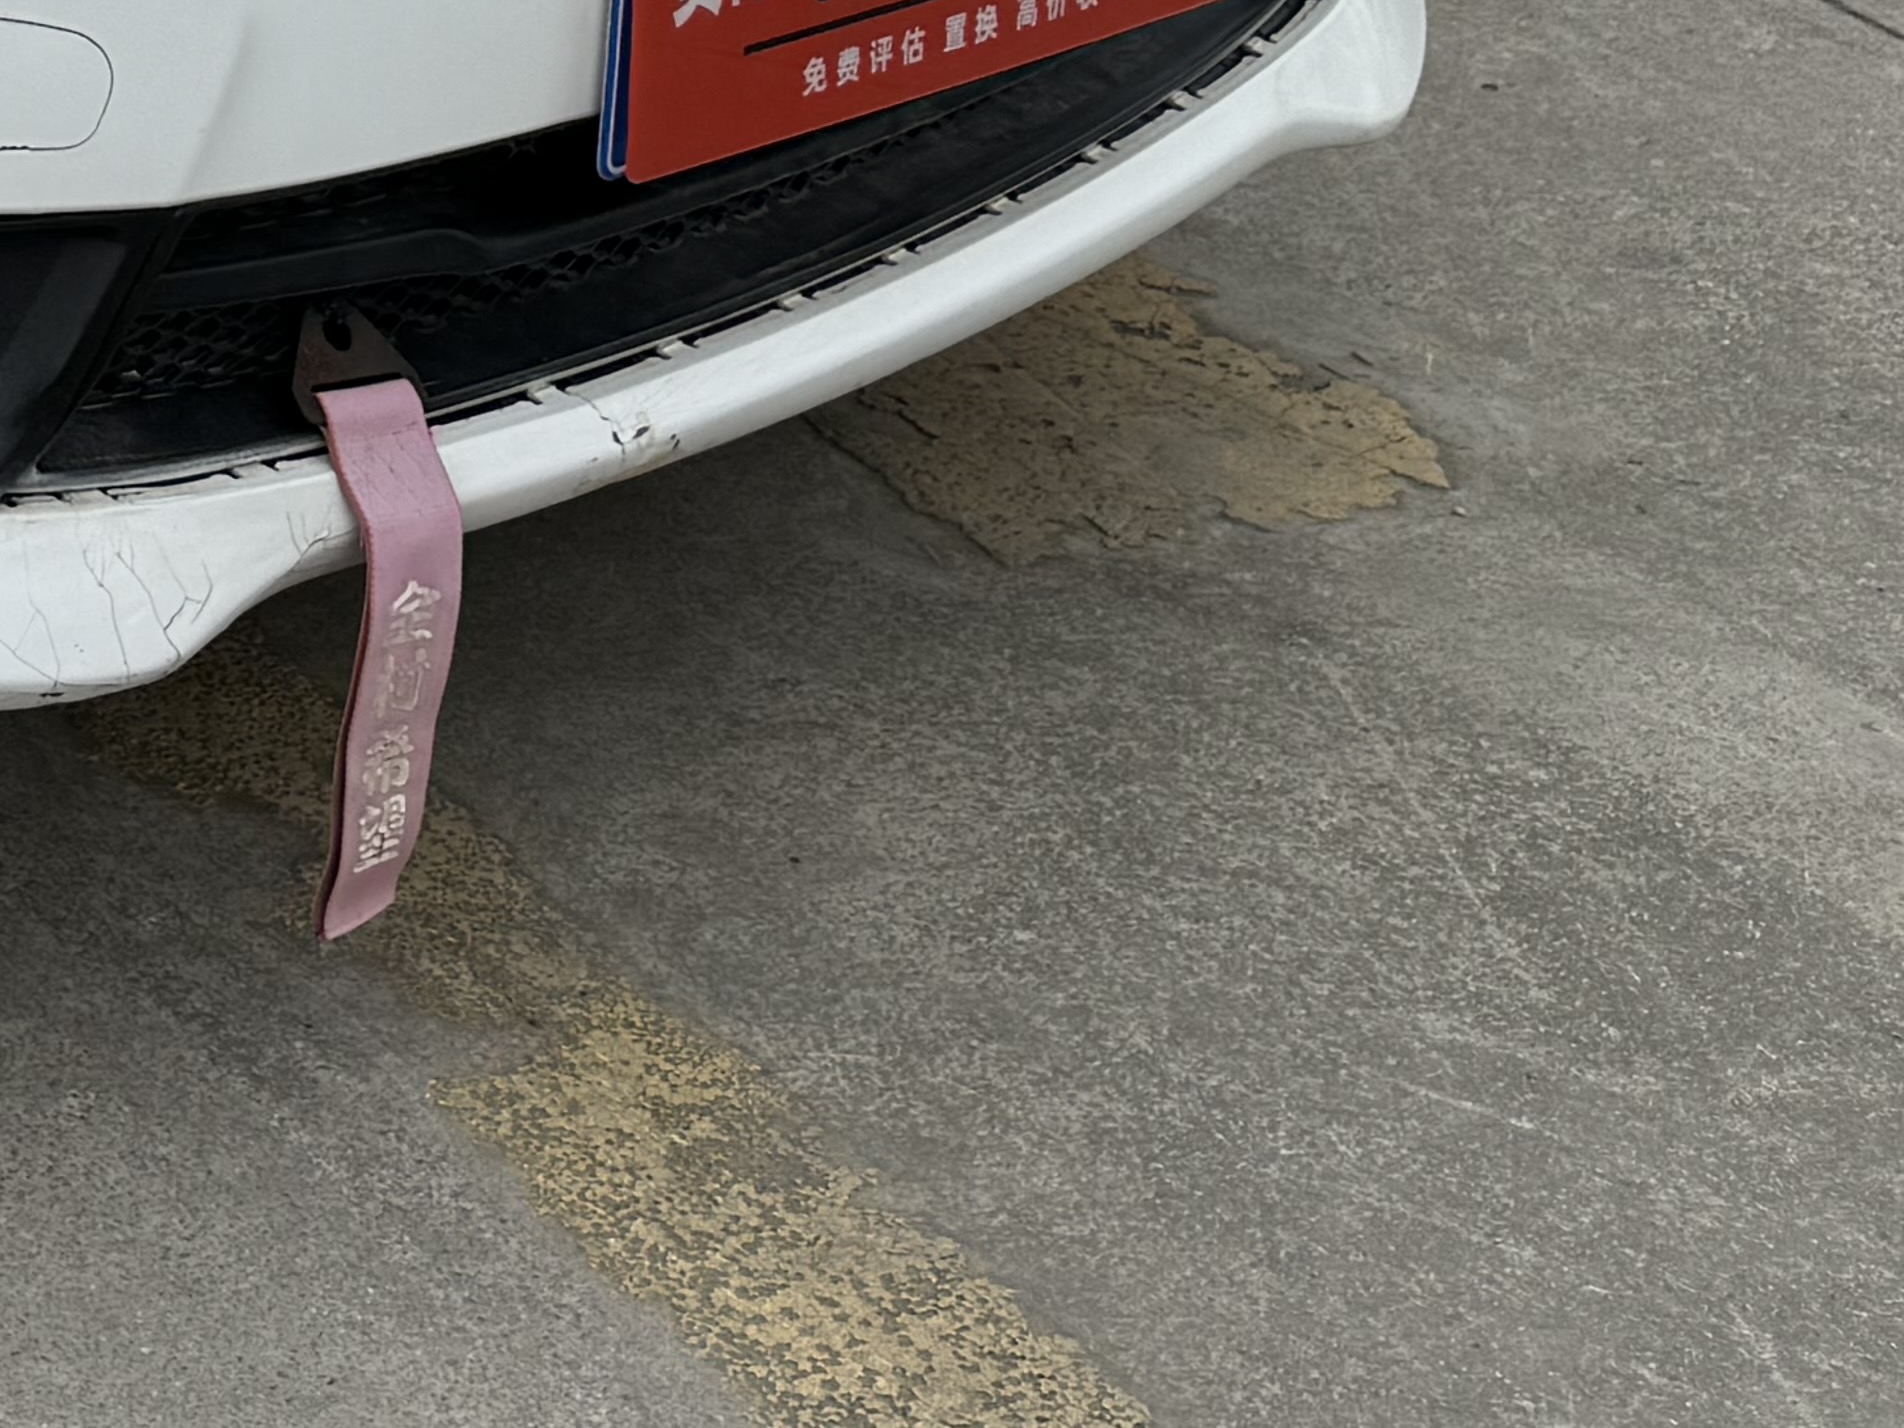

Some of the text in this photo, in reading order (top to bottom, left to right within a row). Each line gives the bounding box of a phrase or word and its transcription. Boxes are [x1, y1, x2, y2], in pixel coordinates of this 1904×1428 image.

[802, 26, 926, 97] 免费评估
[943, 3, 999, 53] 置换
